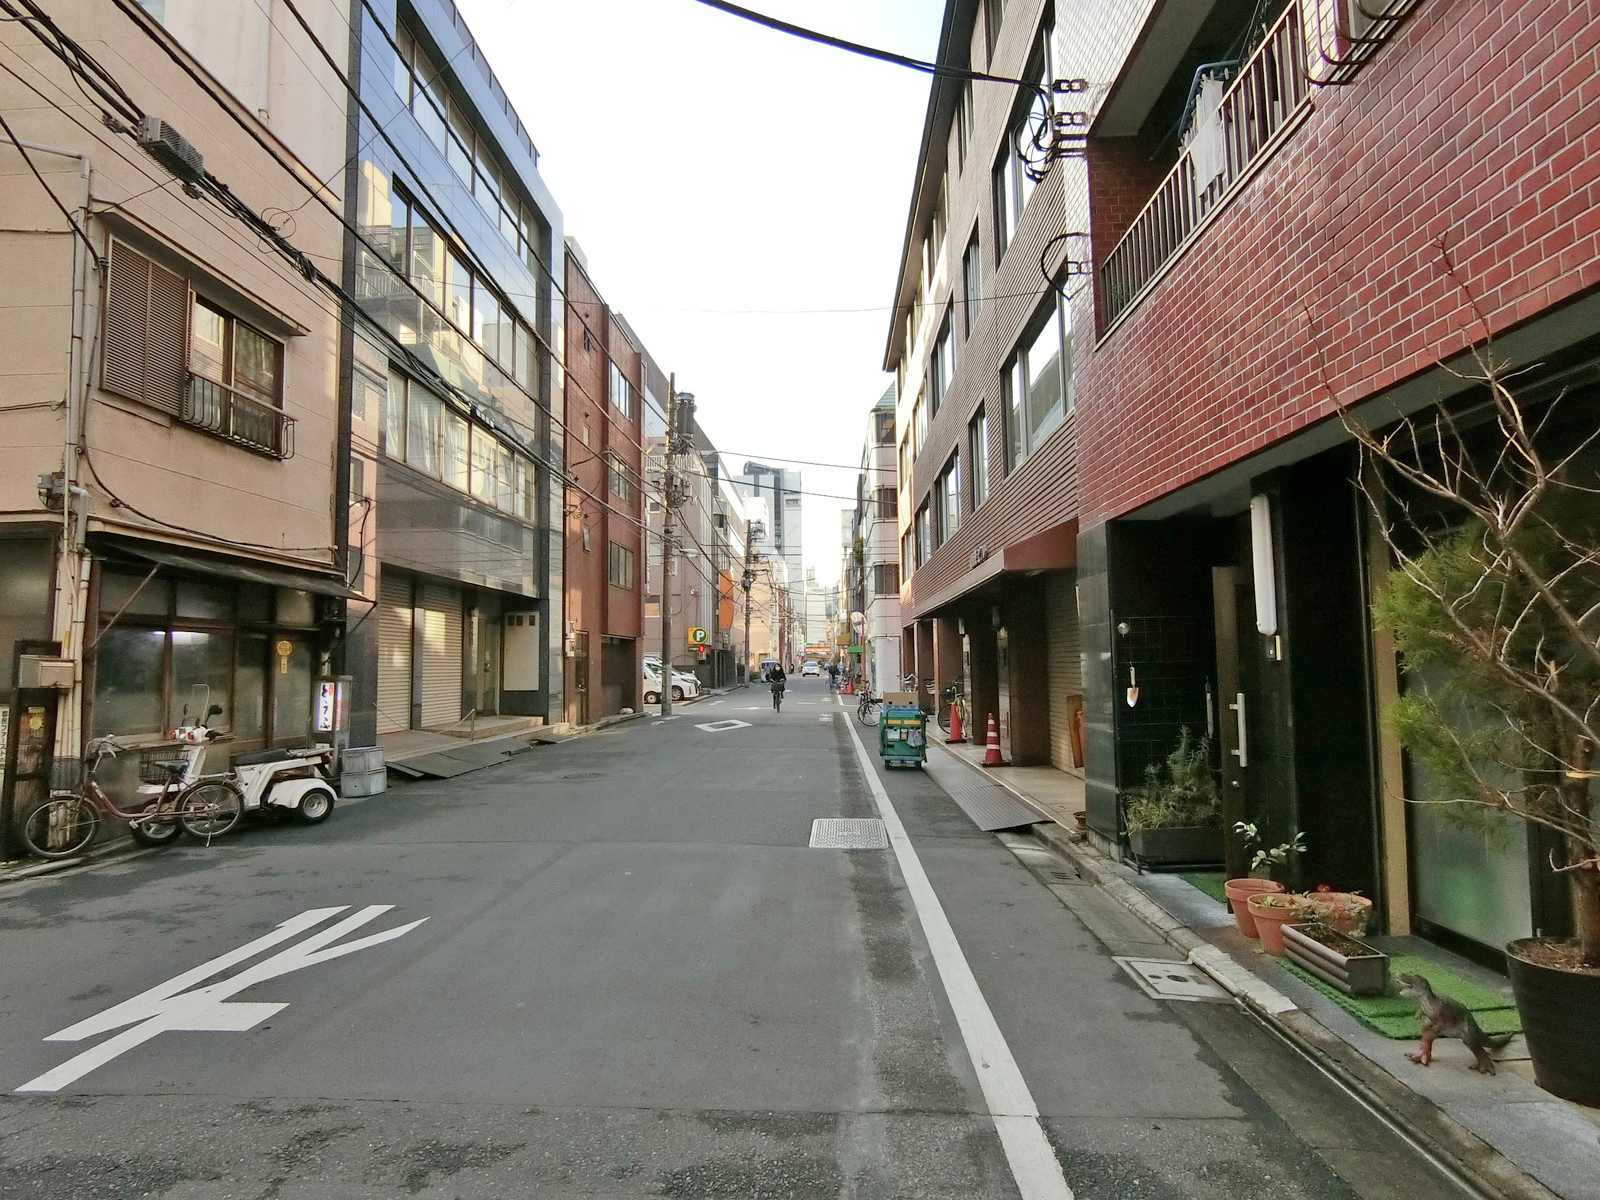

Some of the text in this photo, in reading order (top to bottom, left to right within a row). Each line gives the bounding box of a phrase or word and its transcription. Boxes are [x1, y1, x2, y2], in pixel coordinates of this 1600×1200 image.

[696, 631, 705, 641] P
[320, 684, 330, 729] とうふ
